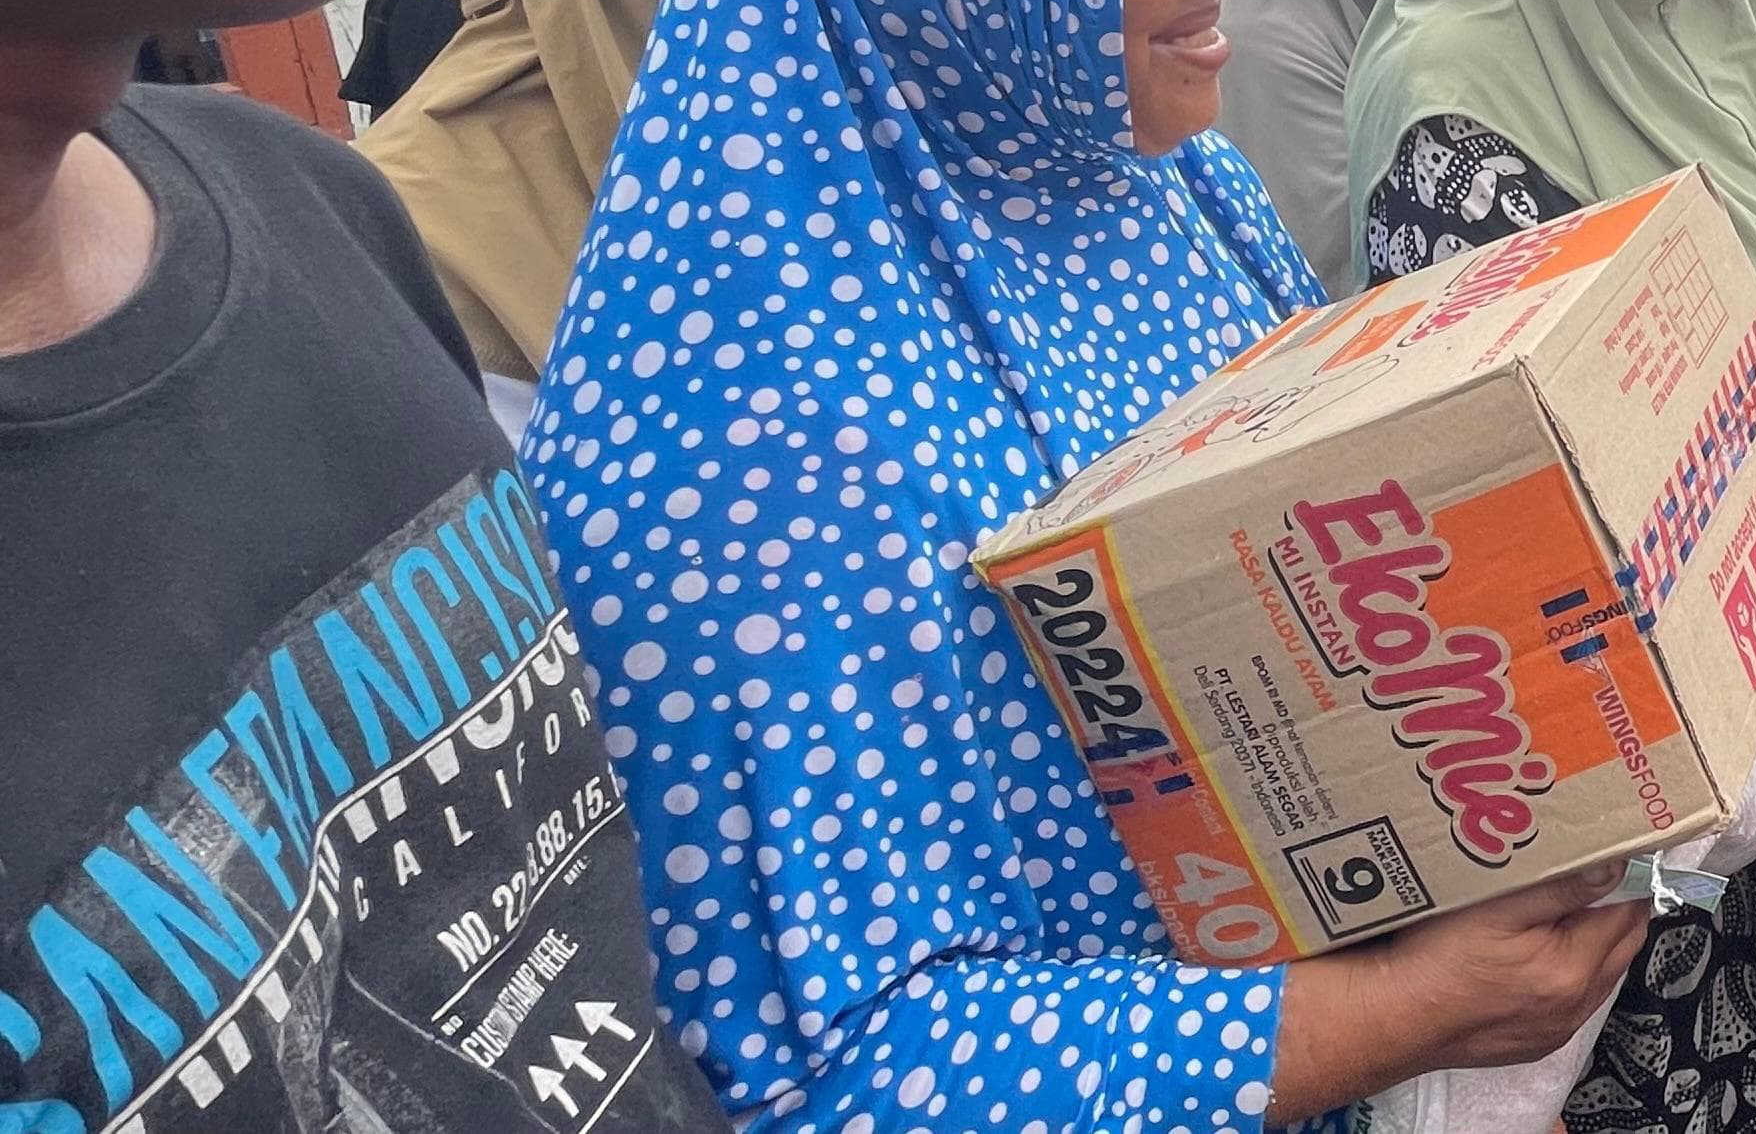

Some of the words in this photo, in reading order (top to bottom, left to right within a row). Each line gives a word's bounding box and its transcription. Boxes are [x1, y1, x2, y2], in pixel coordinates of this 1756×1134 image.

[1273, 535, 1304, 569] MI
[1291, 570, 1356, 668] INSTAN
[1708, 575, 1726, 600] Do
[1721, 547, 1736, 581] not
[1732, 507, 1756, 559] accept
[1013, 564, 1169, 756] 20224
[1227, 526, 1268, 586] RASA
[1255, 584, 1306, 656] KALDU
[1293, 653, 1338, 714] AYAM
[1294, 478, 1550, 856] EkoMie
[180, 456, 555, 912] FRANCISC
[1272, 698, 1288, 718] MD
[1194, 664, 1213, 689] Deli
[1206, 688, 1237, 739] Serdang
[1249, 778, 1289, 837] Indonesia
[1214, 666, 1232, 689] PT.
[1224, 689, 1260, 743] LESTARI
[1250, 741, 1281, 785] ALAM
[1271, 784, 1304, 832] SEGAR
[1262, 721, 1305, 793] Diproduksi
[1296, 791, 1320, 823] oleh
[1593, 685, 1675, 833] WINGSFOOD
[1174, 856, 1276, 959] 40
[1328, 856, 1379, 905] 9
[1365, 830, 1411, 906] MAKSIMUM
[1375, 826, 1422, 904] TUMPUKAN
[436, 910, 499, 972] NO.
[461, 1001, 517, 1069] CUS
[496, 962, 545, 1022] STAMP
